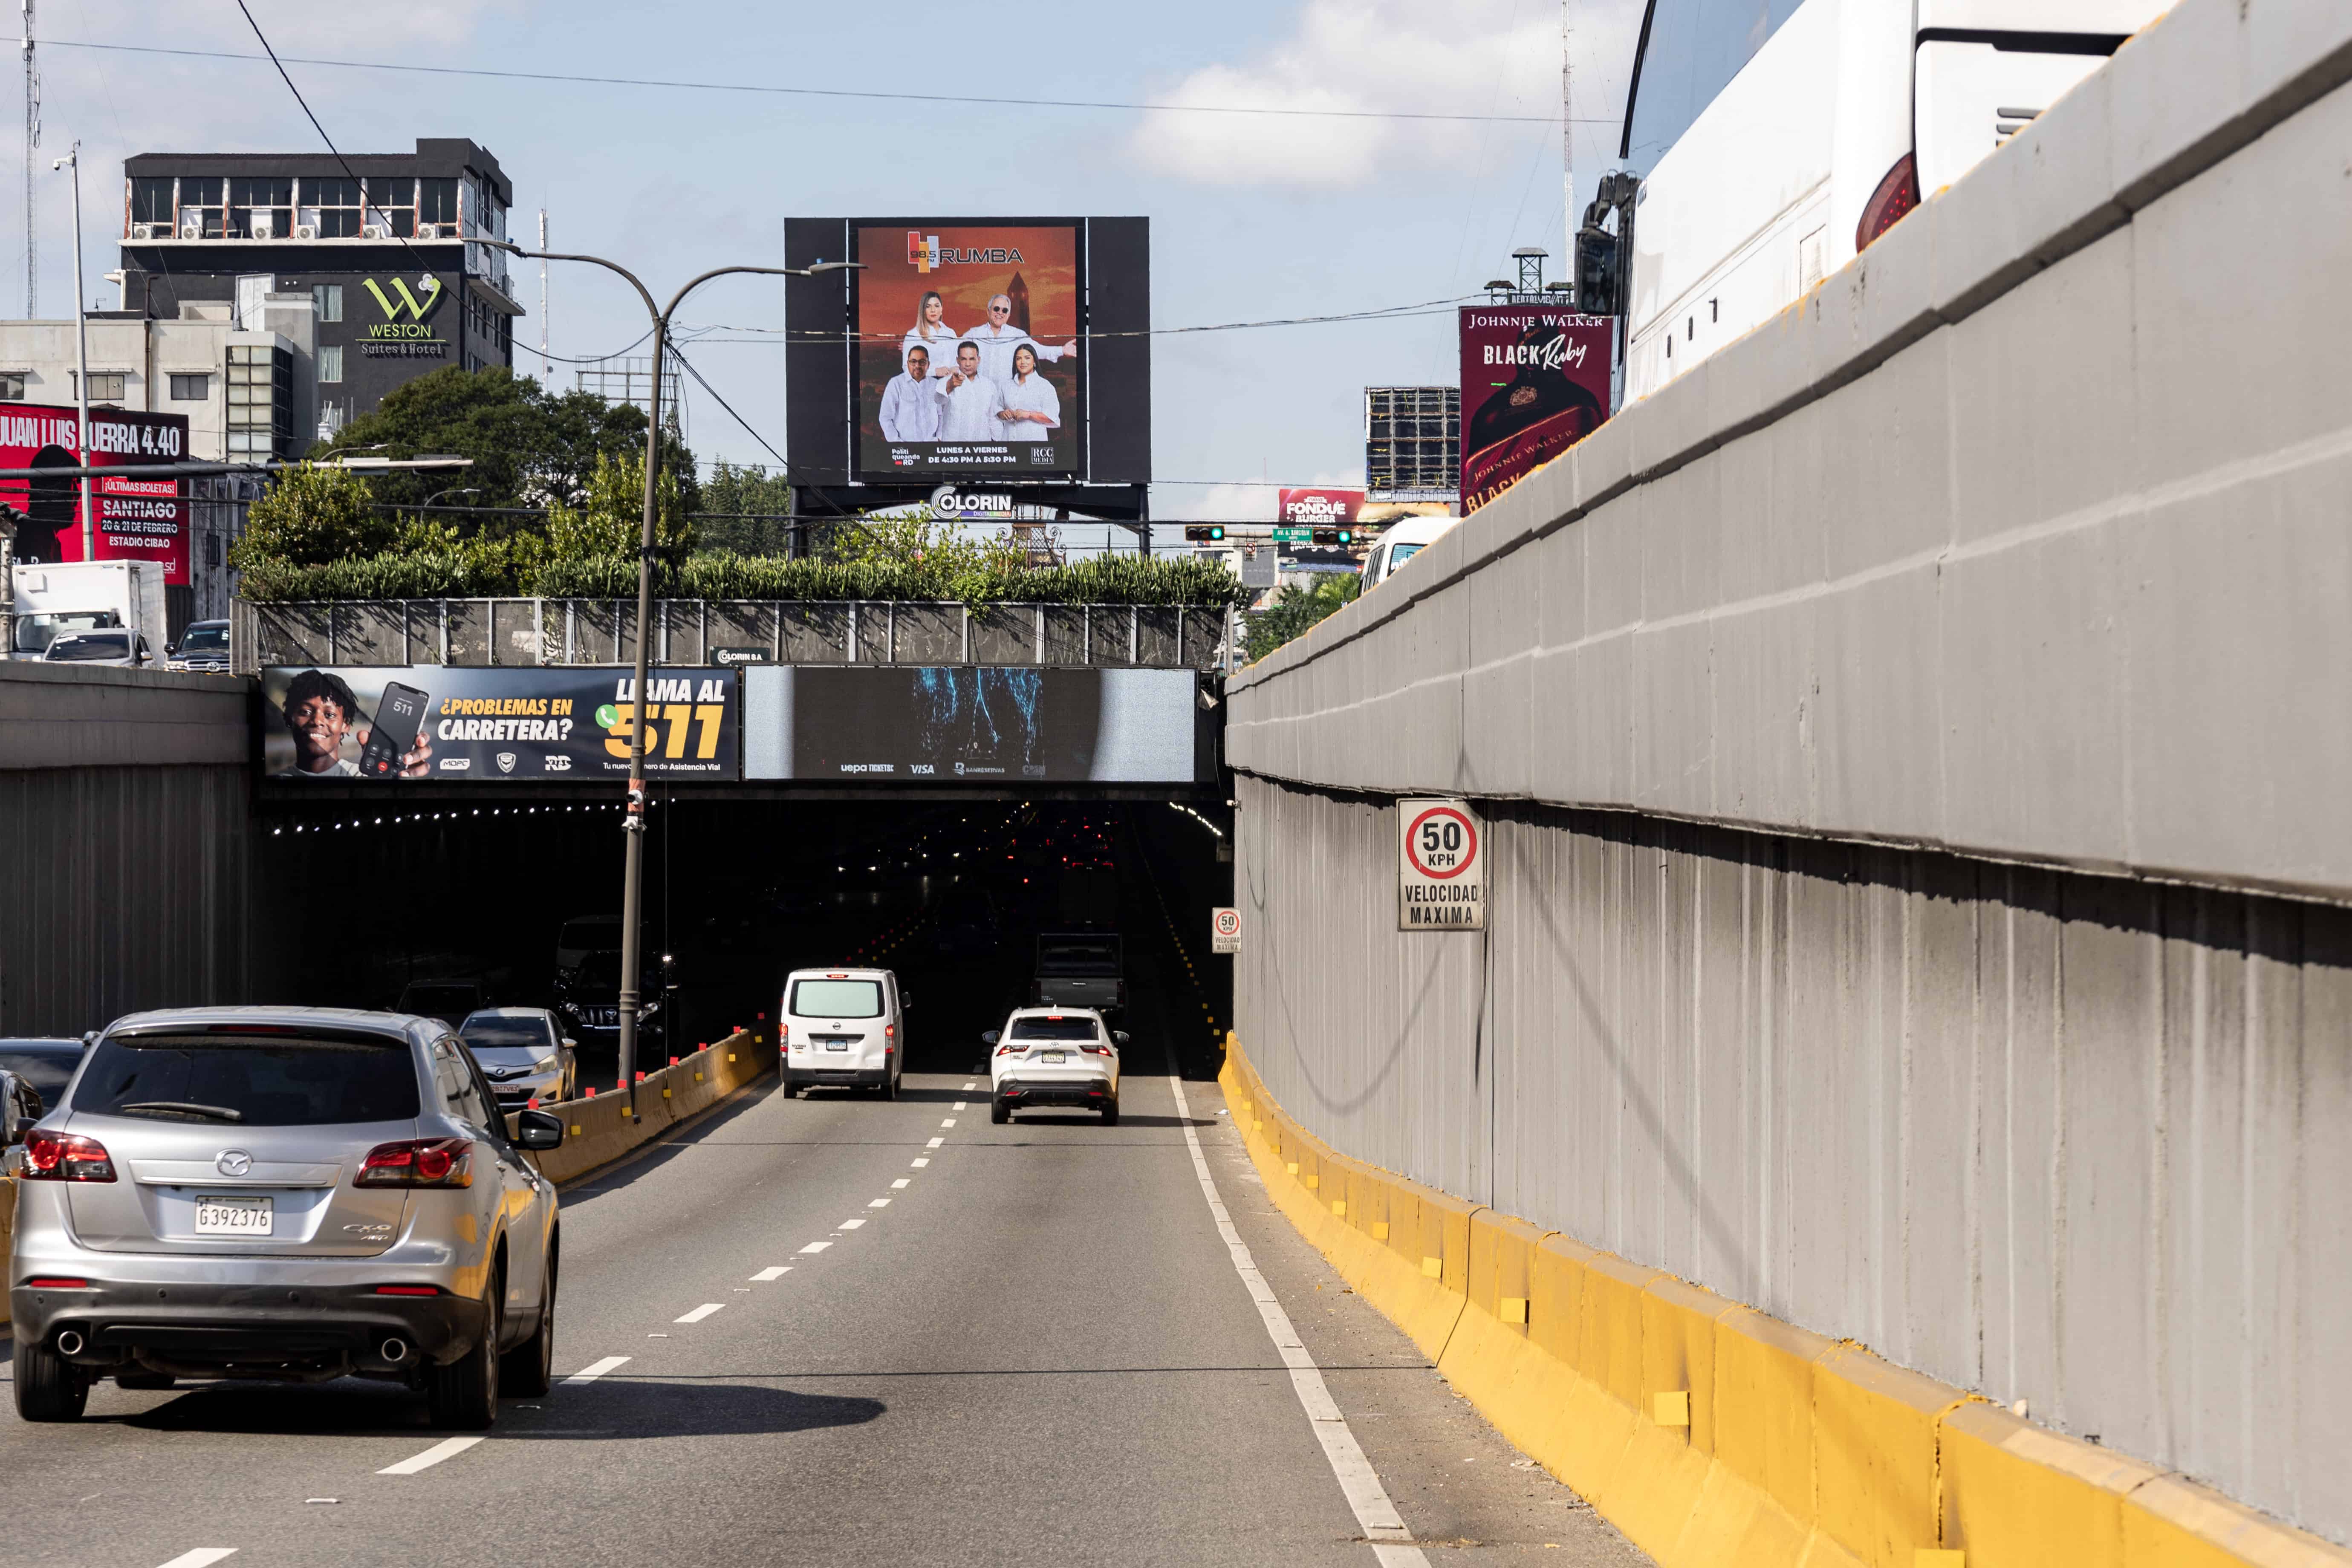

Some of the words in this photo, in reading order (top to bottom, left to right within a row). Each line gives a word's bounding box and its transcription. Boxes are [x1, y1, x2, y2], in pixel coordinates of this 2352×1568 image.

[939, 248, 1025, 263] RUMBA
[1469, 315, 1535, 329] JOHNNIE
[1542, 315, 1603, 326] WALKER
[369, 324, 431, 337] WESTON
[361, 344, 398, 354] Suites
[401, 344, 407, 354] &
[410, 344, 441, 354] Hotel
[1484, 345, 1539, 365] BLACK
[1540, 334, 1587, 370] Ruby
[0, 416, 38, 448] JUAN
[41, 419, 76, 450] LUIS
[88, 422, 139, 453] UERRA
[142, 425, 179, 456] 4.40
[1033, 448, 1052, 457] RCC
[1474, 453, 1522, 482] JOHNNIE
[1524, 430, 1574, 454] WALKER
[105, 478, 139, 492] ¡ÚLTIMAS
[140, 483, 175, 494] BOLETAS!
[103, 500, 176, 519] SANTIAGO
[1286, 502, 1346, 515] FONDUE
[1295, 514, 1336, 523] BURGER
[102, 520, 113, 531] 20
[114, 521, 120, 531] &
[122, 521, 130, 531] 21
[131, 522, 142, 532] DE
[143, 523, 178, 534] FEBRERO
[109, 536, 143, 547] ESTADIO
[144, 538, 170, 549] CIBAO
[696, 679, 725, 702] AL
[393, 701, 413, 716] 511
[440, 698, 548, 715] ¿PROBLEMAS
[551, 699, 573, 715] EN
[438, 719, 573, 741] CARRETERA?
[605, 704, 724, 759] 511
[841, 764, 868, 774] uepa
[909, 765, 935, 774] VISA
[1423, 822, 1461, 851] 50
[1428, 854, 1455, 866] KPH
[1405, 885, 1477, 902] VELOCIDAD
[1222, 916, 1234, 926] 50
[1410, 907, 1473, 924] MAXIMA
[199, 1209, 268, 1227] G392376
[343, 1224, 392, 1233] CX-9
